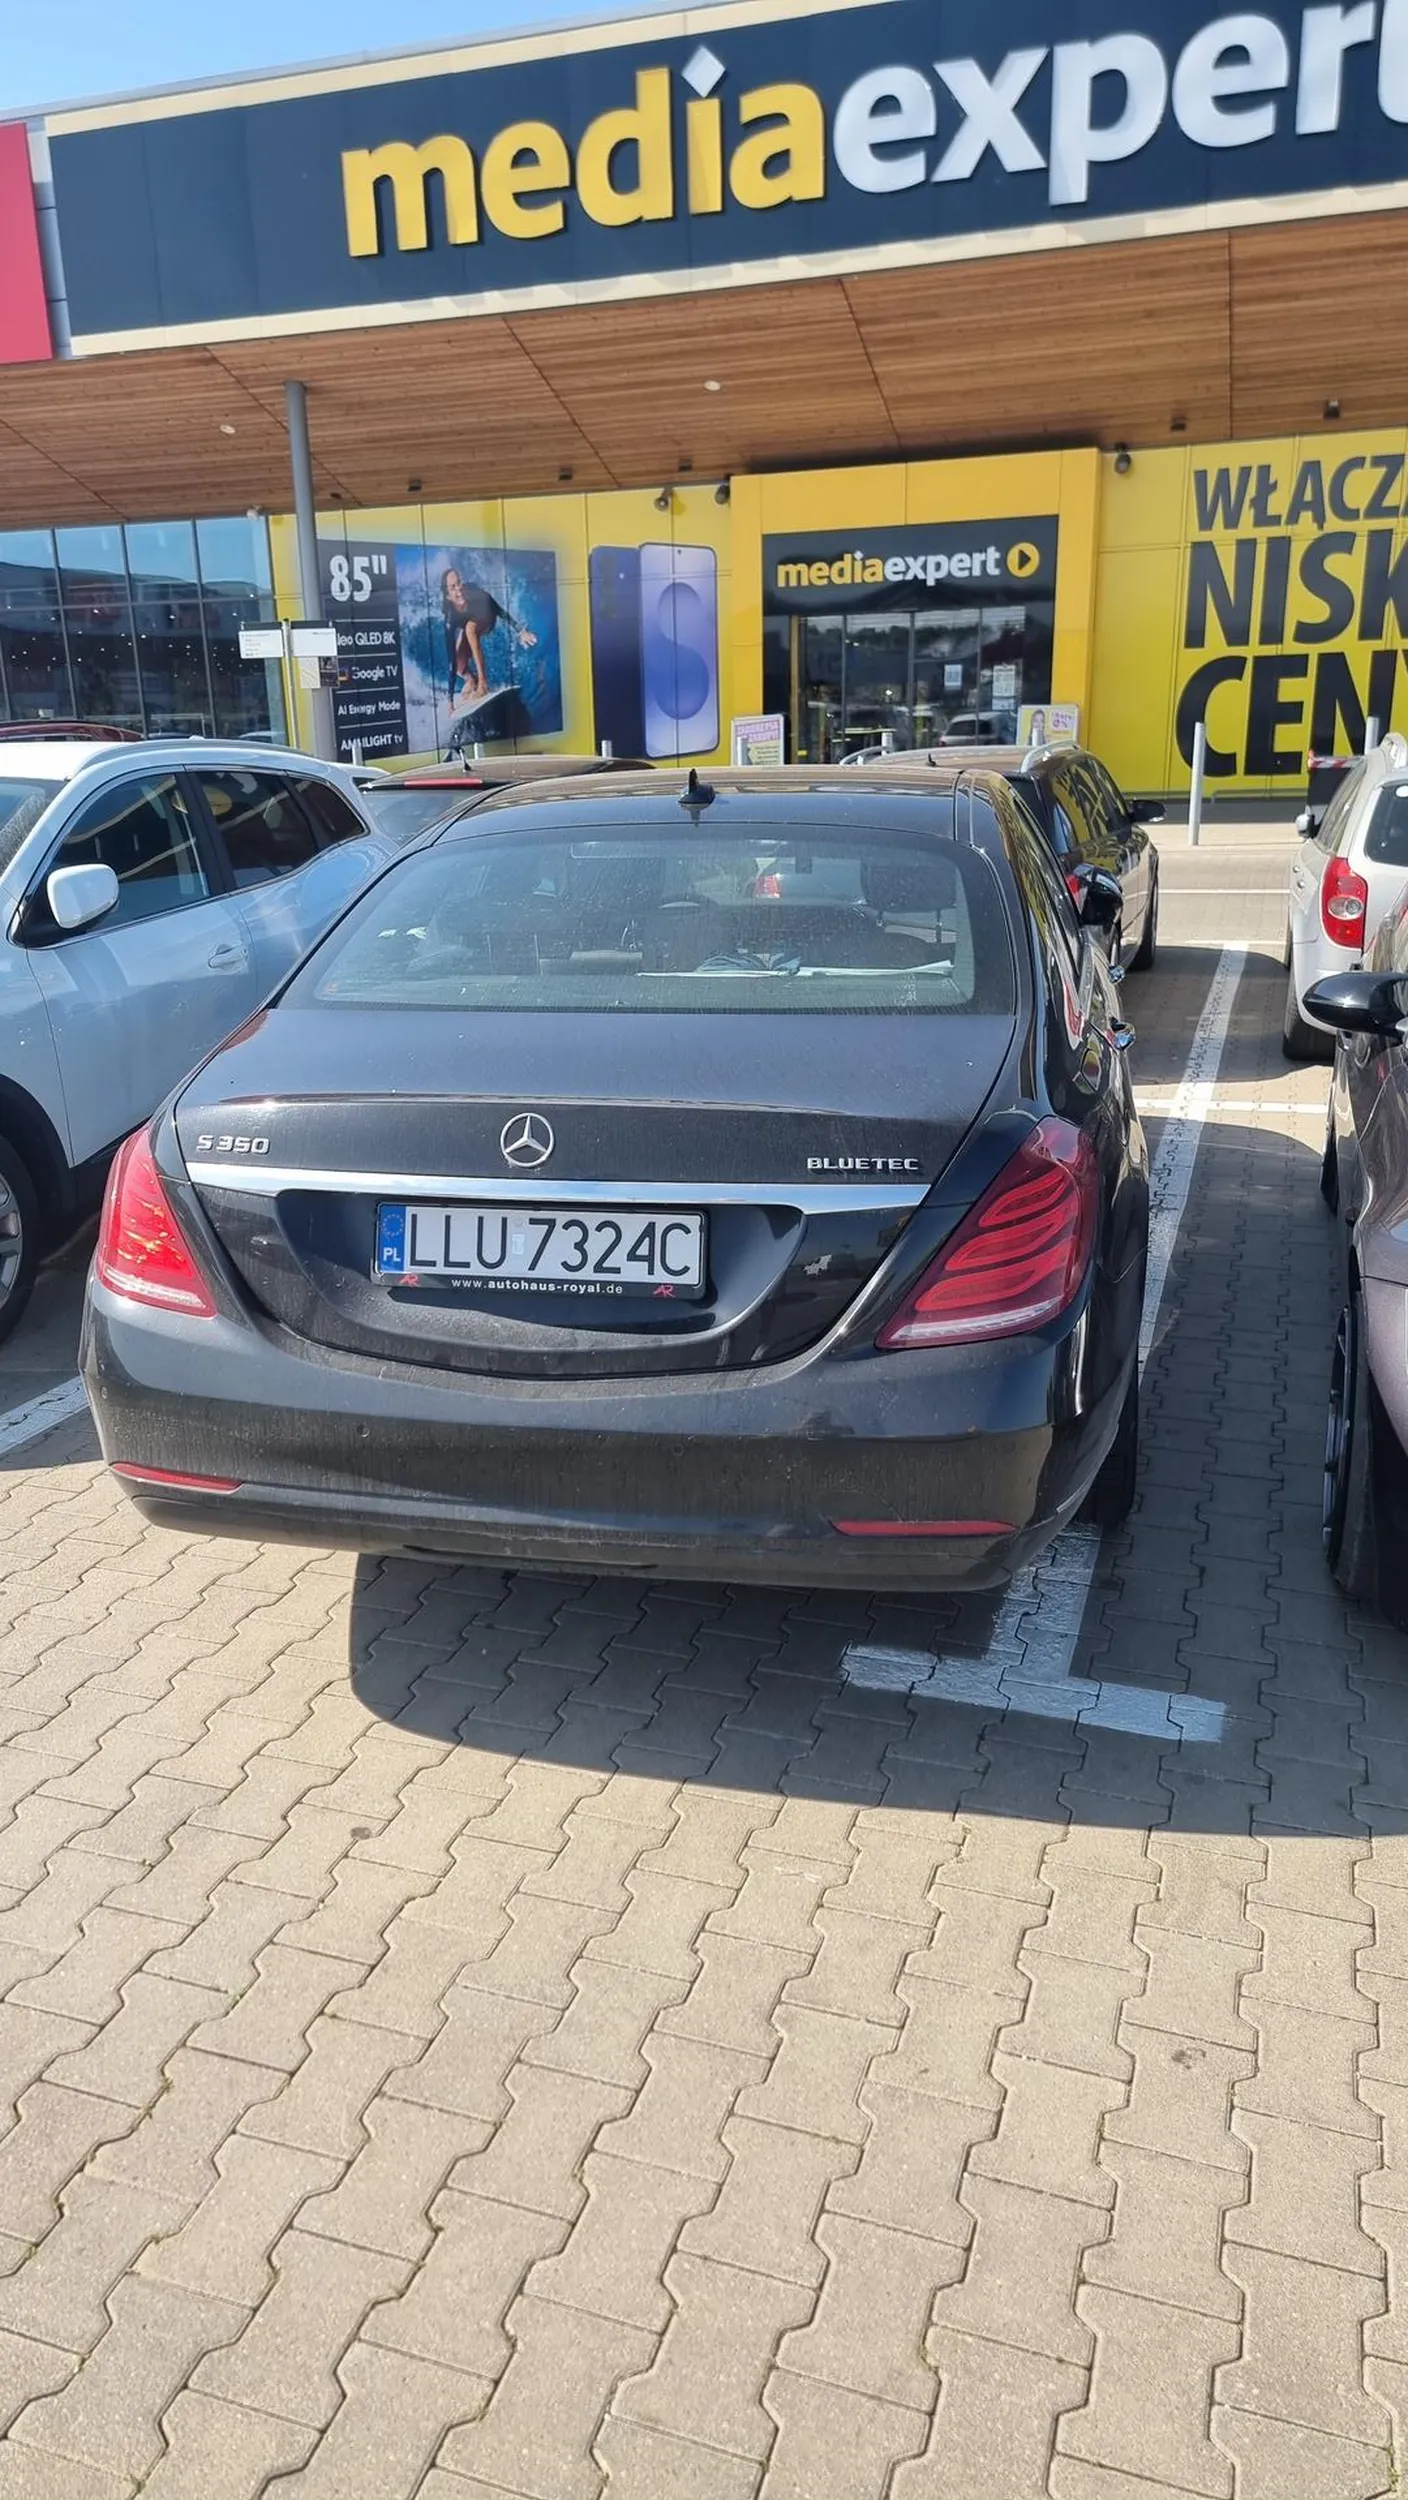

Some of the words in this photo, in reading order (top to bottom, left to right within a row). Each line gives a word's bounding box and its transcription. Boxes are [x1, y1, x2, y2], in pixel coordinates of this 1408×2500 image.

[1193, 453, 1408, 532] WŁĄCZ
[777, 545, 1001, 588] mediaexpert
[329, 554, 388, 602] 85"
[355, 631, 382, 646] QLED
[383, 630, 397, 645] 8K
[351, 664, 385, 681] Google
[386, 665, 399, 677] TV
[378, 700, 401, 712] Mode
[1175, 649, 1408, 778] CEN
[196, 1134, 214, 1151] S
[216, 1135, 270, 1155] 350
[806, 1157, 919, 1171] BLUETEC
[383, 1247, 401, 1262] PL
[410, 1213, 508, 1270] LLU
[527, 1217, 691, 1277] 7324C
[451, 1277, 623, 1295] www.autohaus-royal.de
